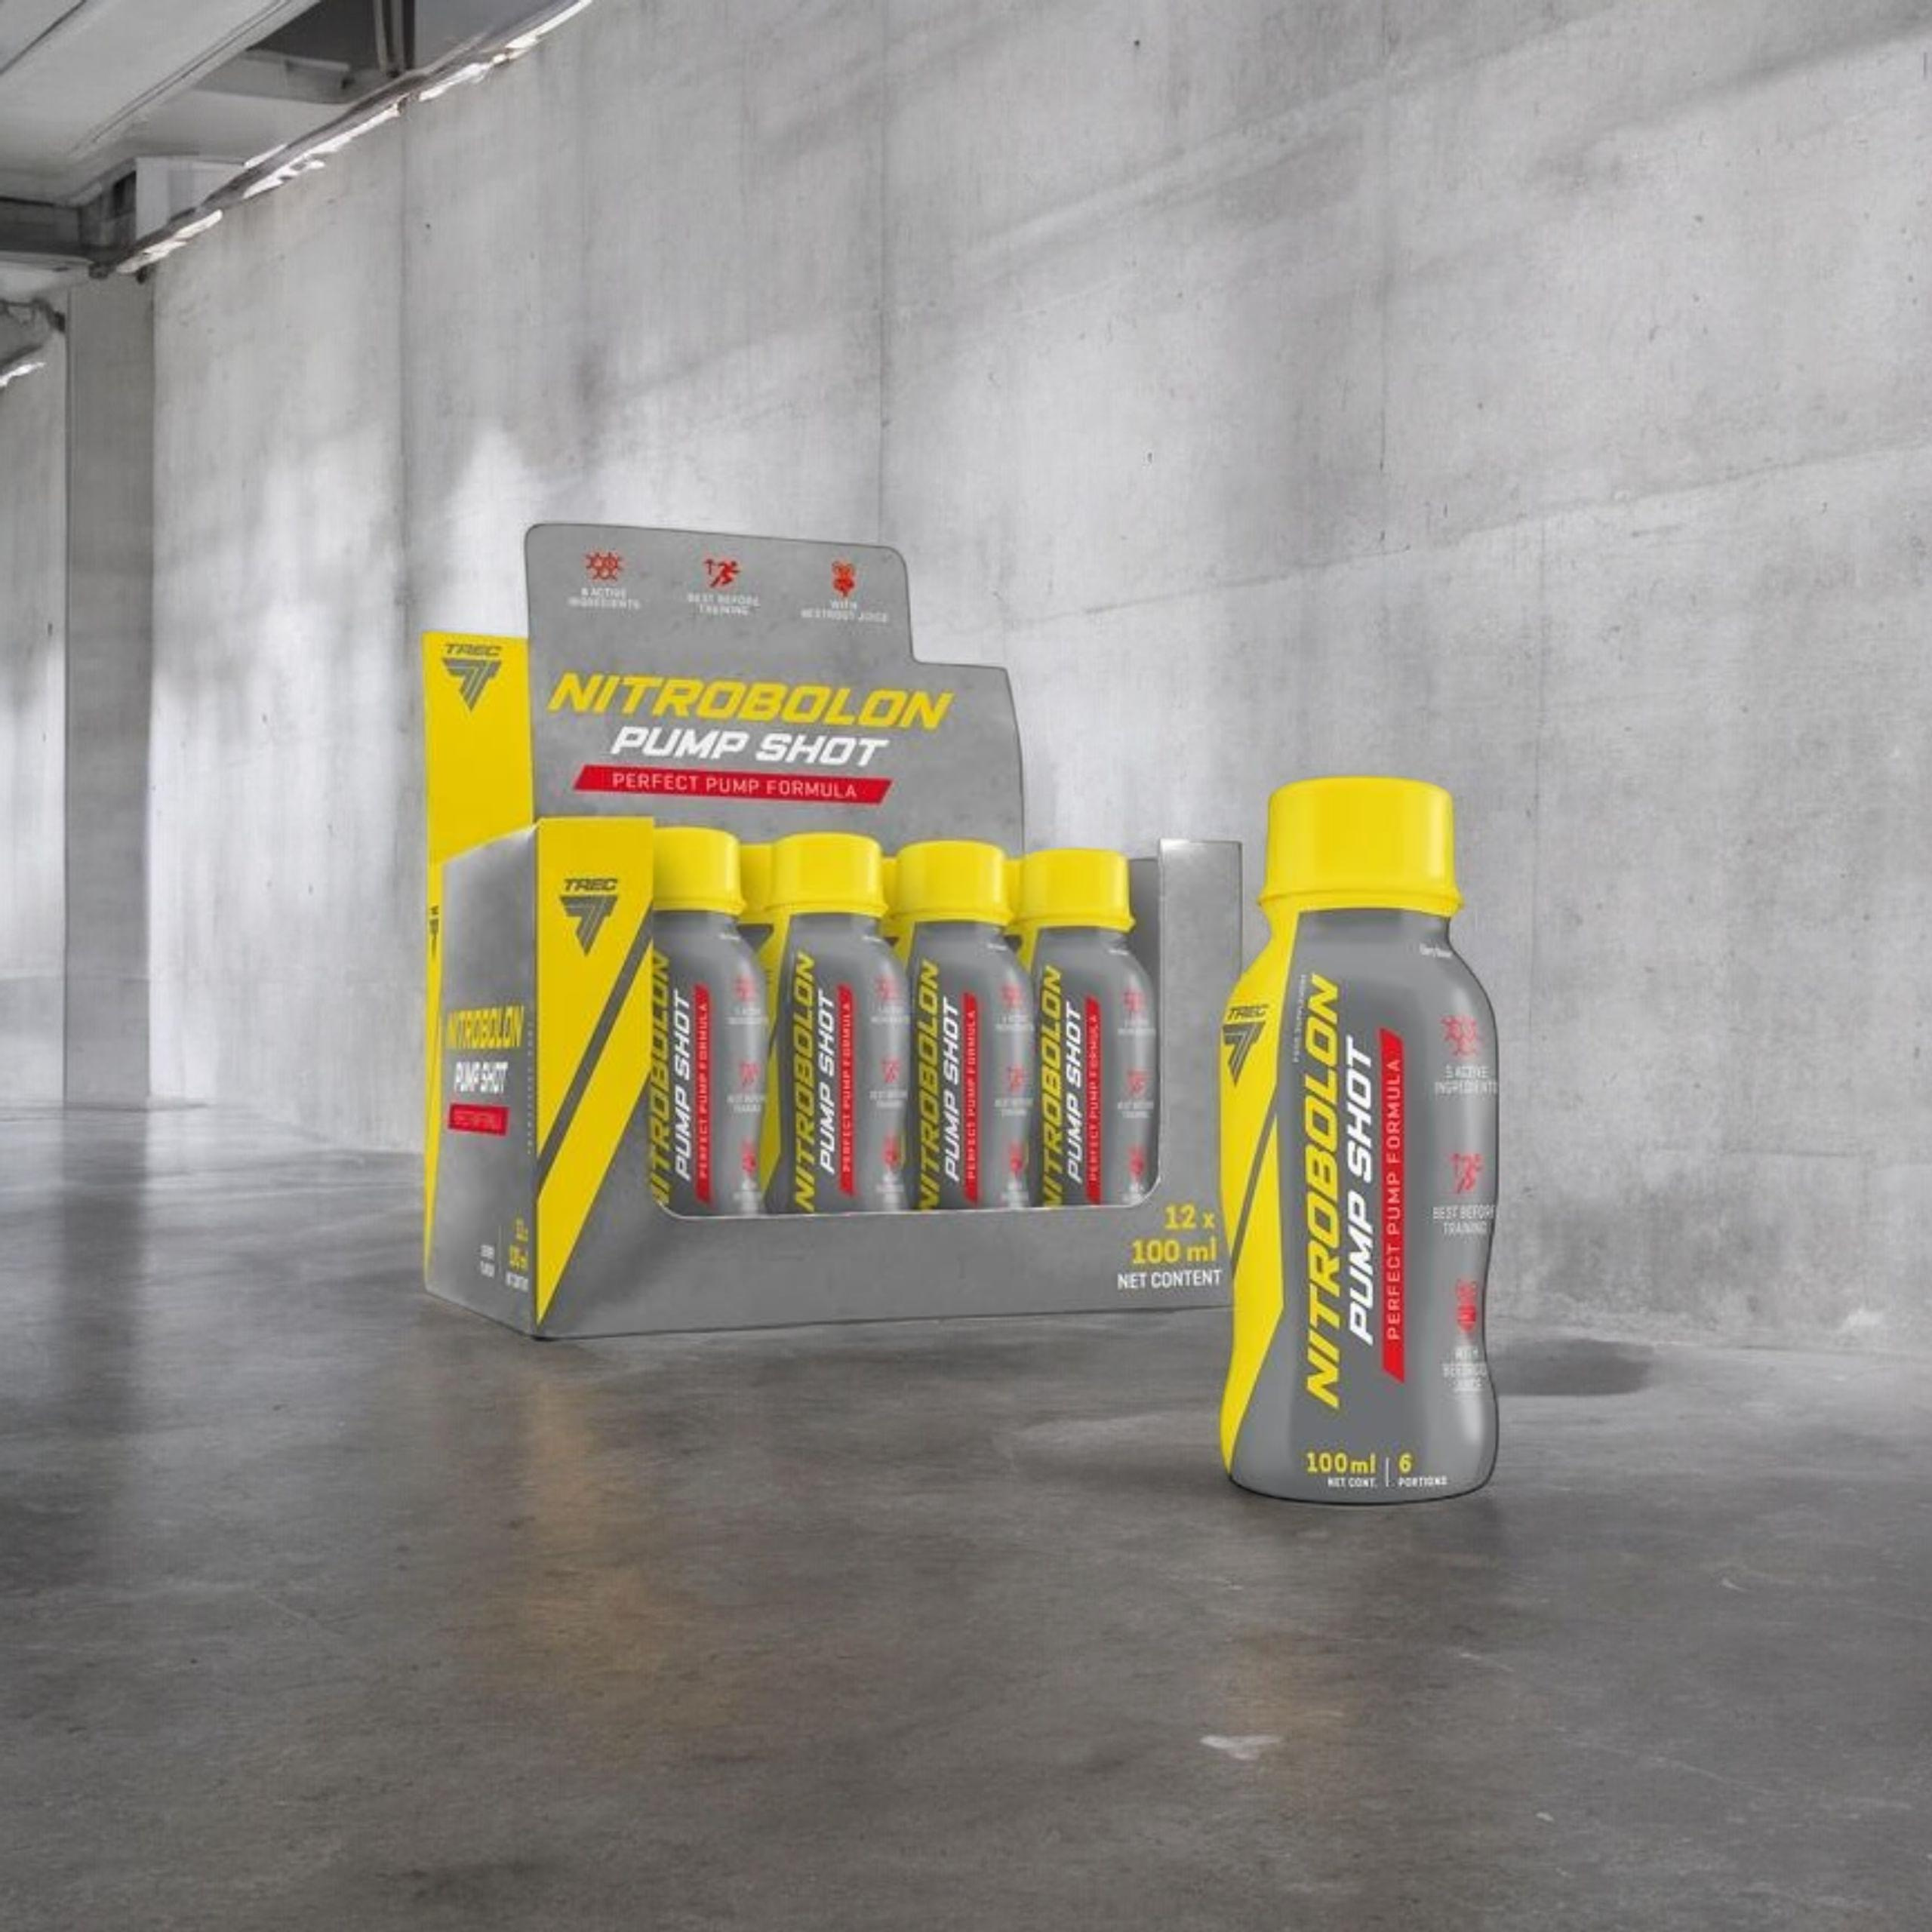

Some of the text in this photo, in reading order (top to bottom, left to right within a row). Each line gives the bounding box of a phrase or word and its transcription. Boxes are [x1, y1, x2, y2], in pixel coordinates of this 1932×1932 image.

[445, 644, 501, 657] TREC
[548, 672, 953, 731] NITROBOLON
[611, 726, 890, 768] PUMP SHOT
[612, 772, 857, 798] PERFECT PUMP FORMULA
[564, 878, 619, 891] TREC
[448, 1004, 525, 1049] NITROBOLON
[1227, 1004, 1269, 1020] TREC
[673, 988, 691, 1182] PUMP SHOT
[699, 1073, 709, 1115] PUMP
[794, 952, 815, 1213] NITROBOLON
[819, 988, 835, 1175] PUMP SHOT
[842, 1069, 851, 1110] PUMP
[943, 996, 959, 1182] PUMP SHOT
[967, 1077, 976, 1118] PUMP
[1066, 1001, 1082, 1184] PUMP SHOT
[699, 1119, 709, 1179] PERFECT
[842, 1114, 851, 1173] PERFECT
[967, 1121, 976, 1180] PERFECT
[1305, 972, 1340, 1409] NITROBOLON
[1346, 1035, 1374, 1346] PUMP SHOT
[1386, 1059, 1401, 1340] PERFECT PUMP FORMULA
[1165, 1204, 1215, 1229] 12 x
[1433, 1206, 1458, 1220] BEST
[1133, 1236, 1217, 1264] 100 ml
[1118, 1269, 1222, 1290] NET CONTENT
[1306, 1452, 1413, 1473] 100ml 6
[1327, 1477, 1345, 1487] NET
[1398, 1475, 1447, 1487] PORTIONS
